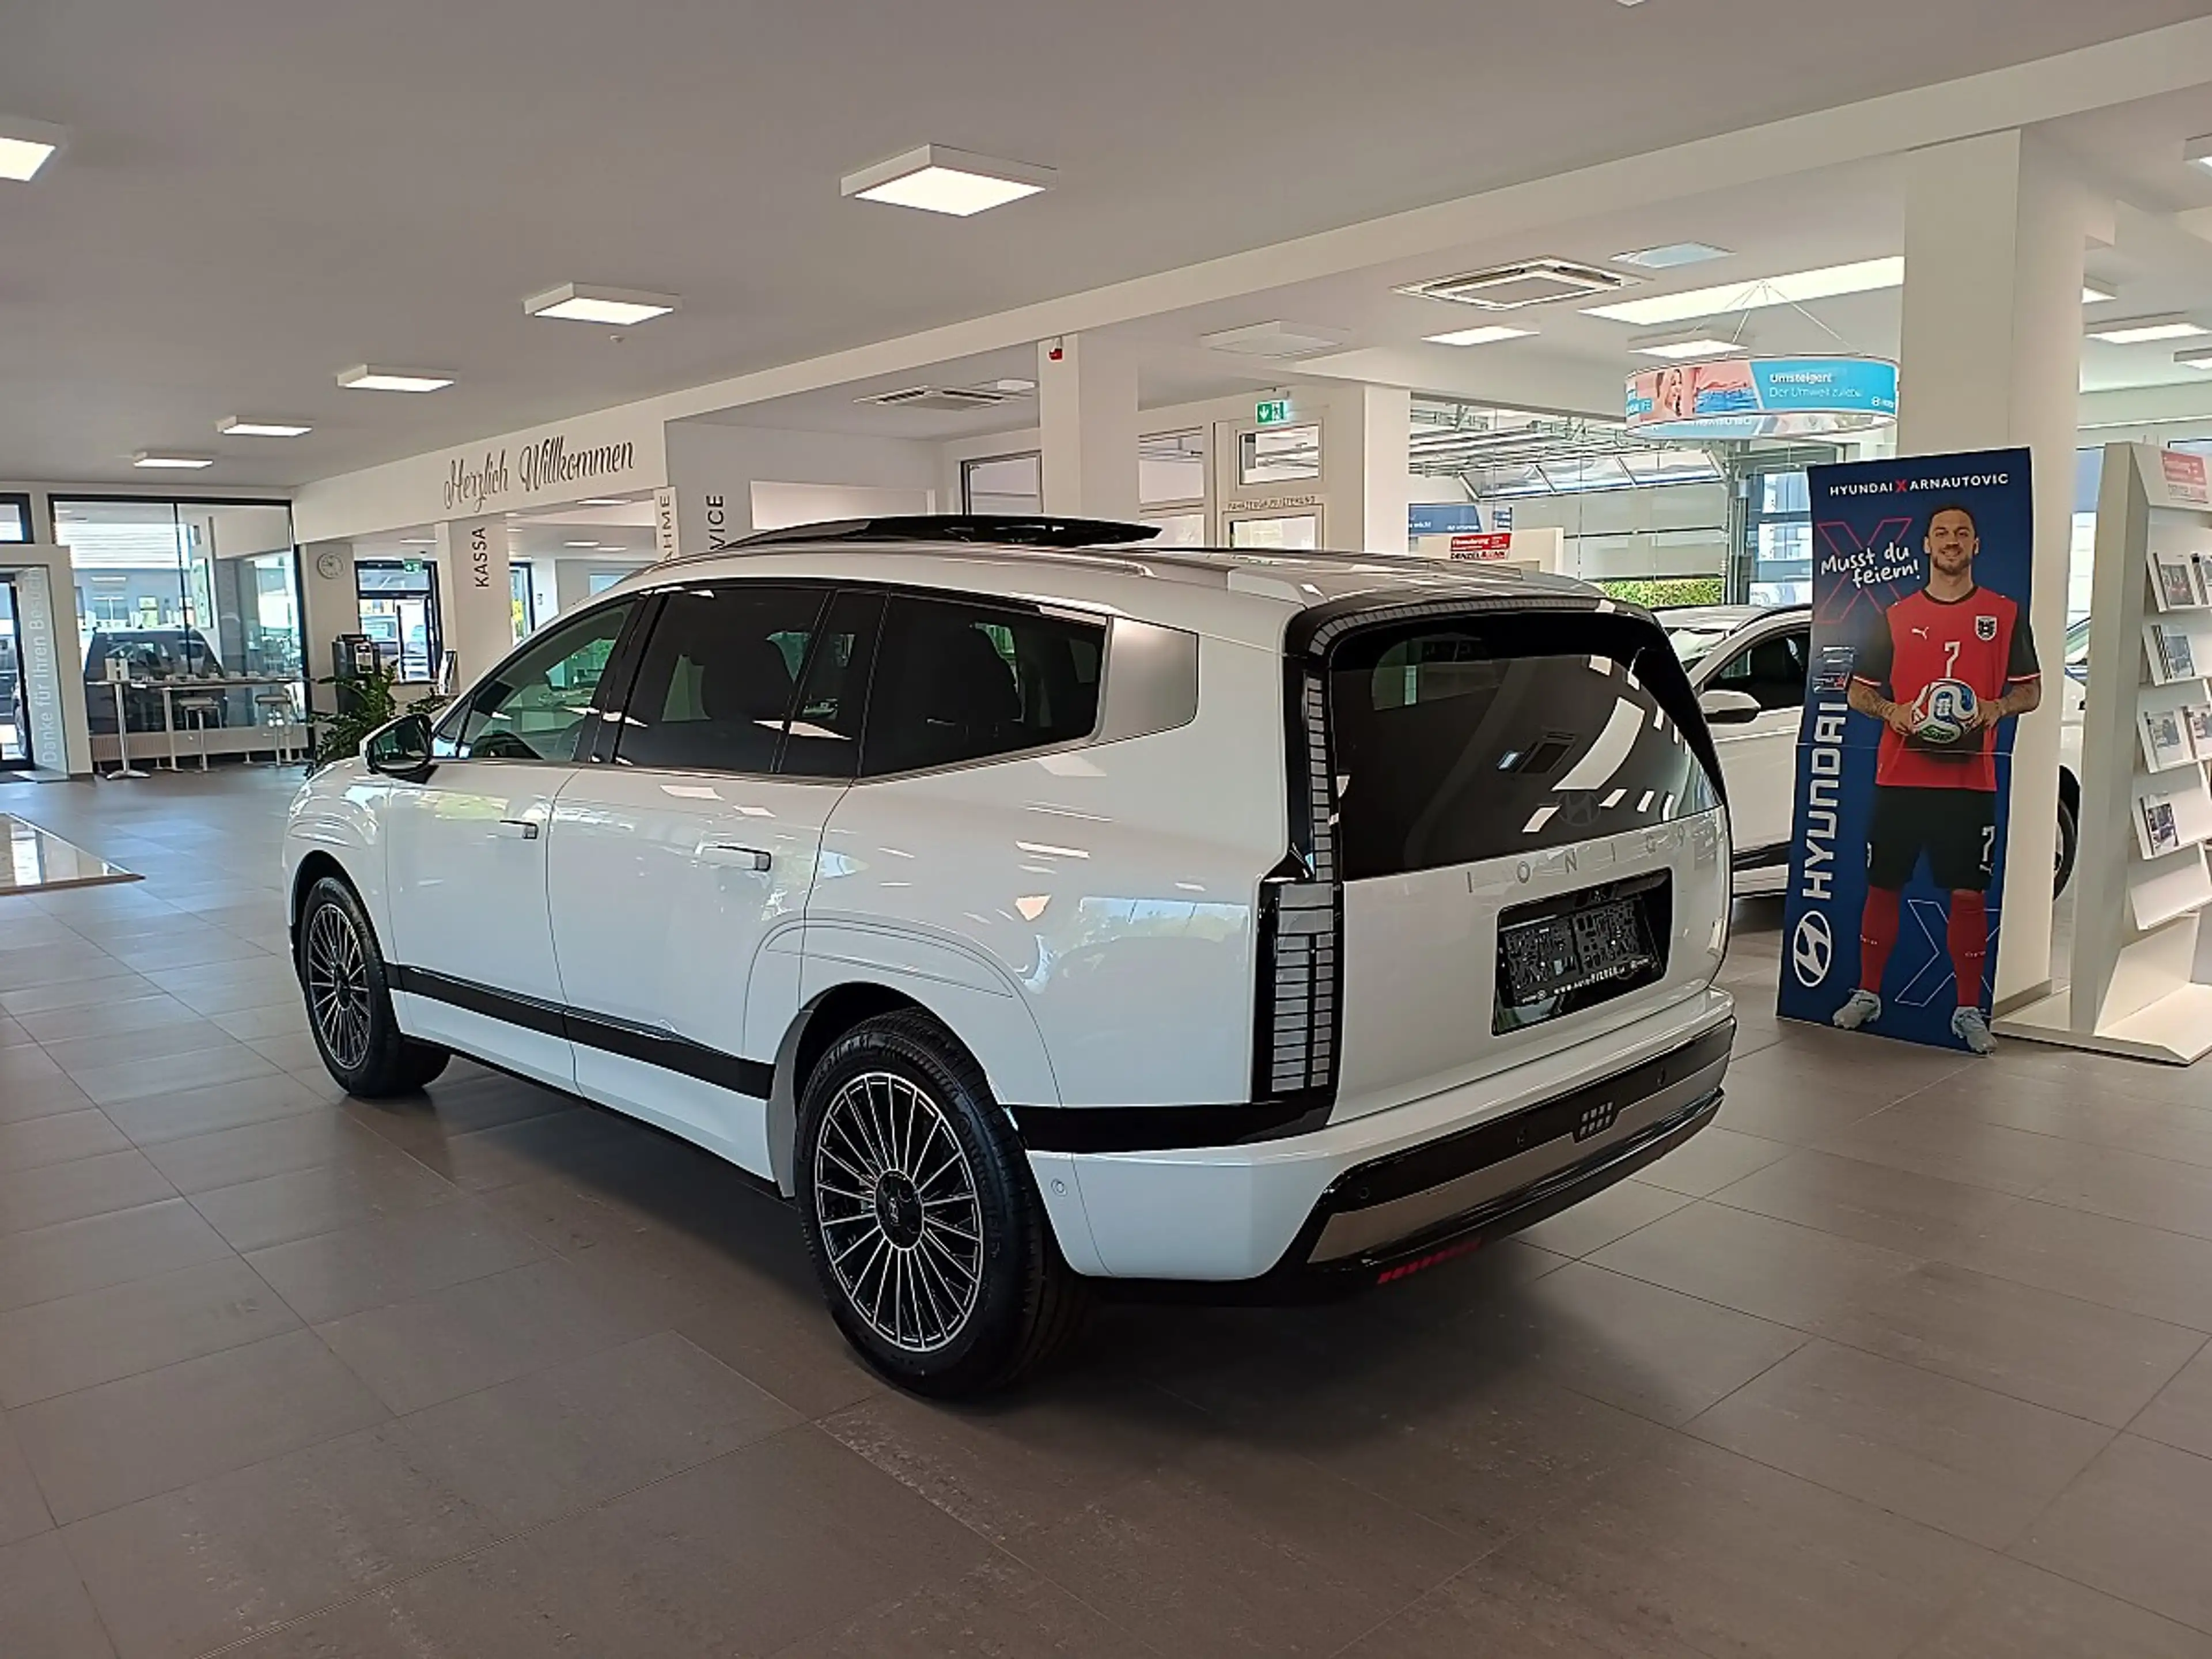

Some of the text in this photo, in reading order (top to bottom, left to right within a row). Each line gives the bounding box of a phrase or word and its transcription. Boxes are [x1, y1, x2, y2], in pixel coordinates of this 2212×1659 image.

[444, 435, 634, 513] Herzlich Willkommen
[1830, 482, 1893, 497] HYUNDAI
[1909, 474, 2009, 491] ARNAUTOVIC
[472, 527, 489, 587] KASSA
[1820, 541, 1910, 575] Musst du
[1852, 559, 1921, 589] feiern!
[32, 636, 48, 677] Ihren
[1944, 641, 1960, 678] 7
[35, 684, 51, 707] für
[40, 711, 57, 763] Danke
[1802, 702, 1849, 900] HYUNDAI
[1982, 825, 1995, 862] 7
